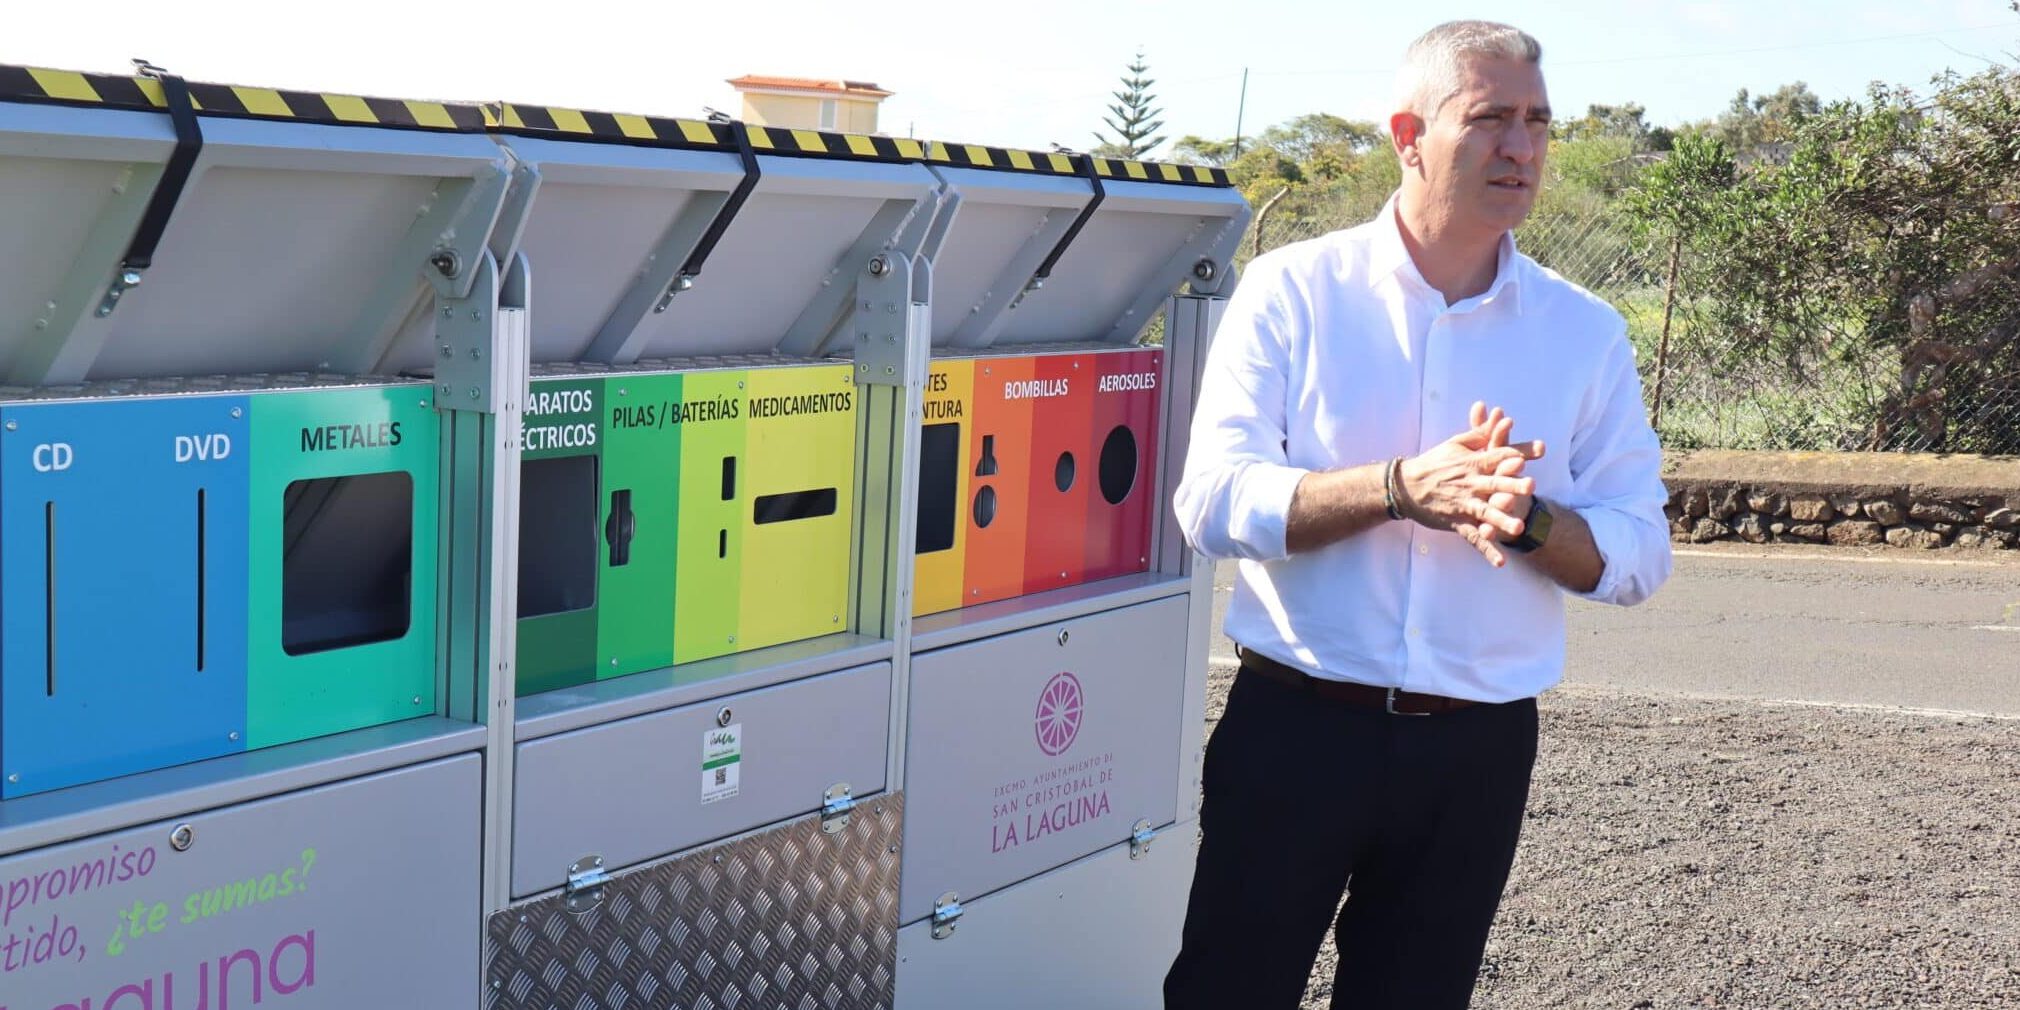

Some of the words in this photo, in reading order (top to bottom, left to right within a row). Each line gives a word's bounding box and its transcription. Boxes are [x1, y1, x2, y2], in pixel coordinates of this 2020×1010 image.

[928, 373, 947, 392] TES
[1004, 378, 1069, 400] BOMBILLAS
[1099, 372, 1156, 393] AEROSOLES
[526, 389, 593, 416] ARATOS
[613, 403, 656, 429] PILAS
[658, 402, 668, 430] /
[671, 394, 739, 424] BATERÍAS
[749, 391, 852, 419] MEDICAMENTOS
[922, 399, 963, 420] NTURA
[175, 433, 231, 463] DVD
[300, 421, 402, 453] METALES
[520, 422, 596, 451] ÉCTRICOS
[32, 442, 73, 472] CD
[1034, 757, 1101, 785] AYUNTAMIENTO
[993, 798, 1019, 819] SAN
[1100, 768, 1113, 785] DE
[992, 821, 1018, 854] LA
[1026, 790, 1111, 842] LAGUNA
[0, 844, 156, 927] promiso
[0, 914, 86, 972] tido,
[106, 899, 170, 957] ¿te
[180, 848, 317, 925] sumas?
